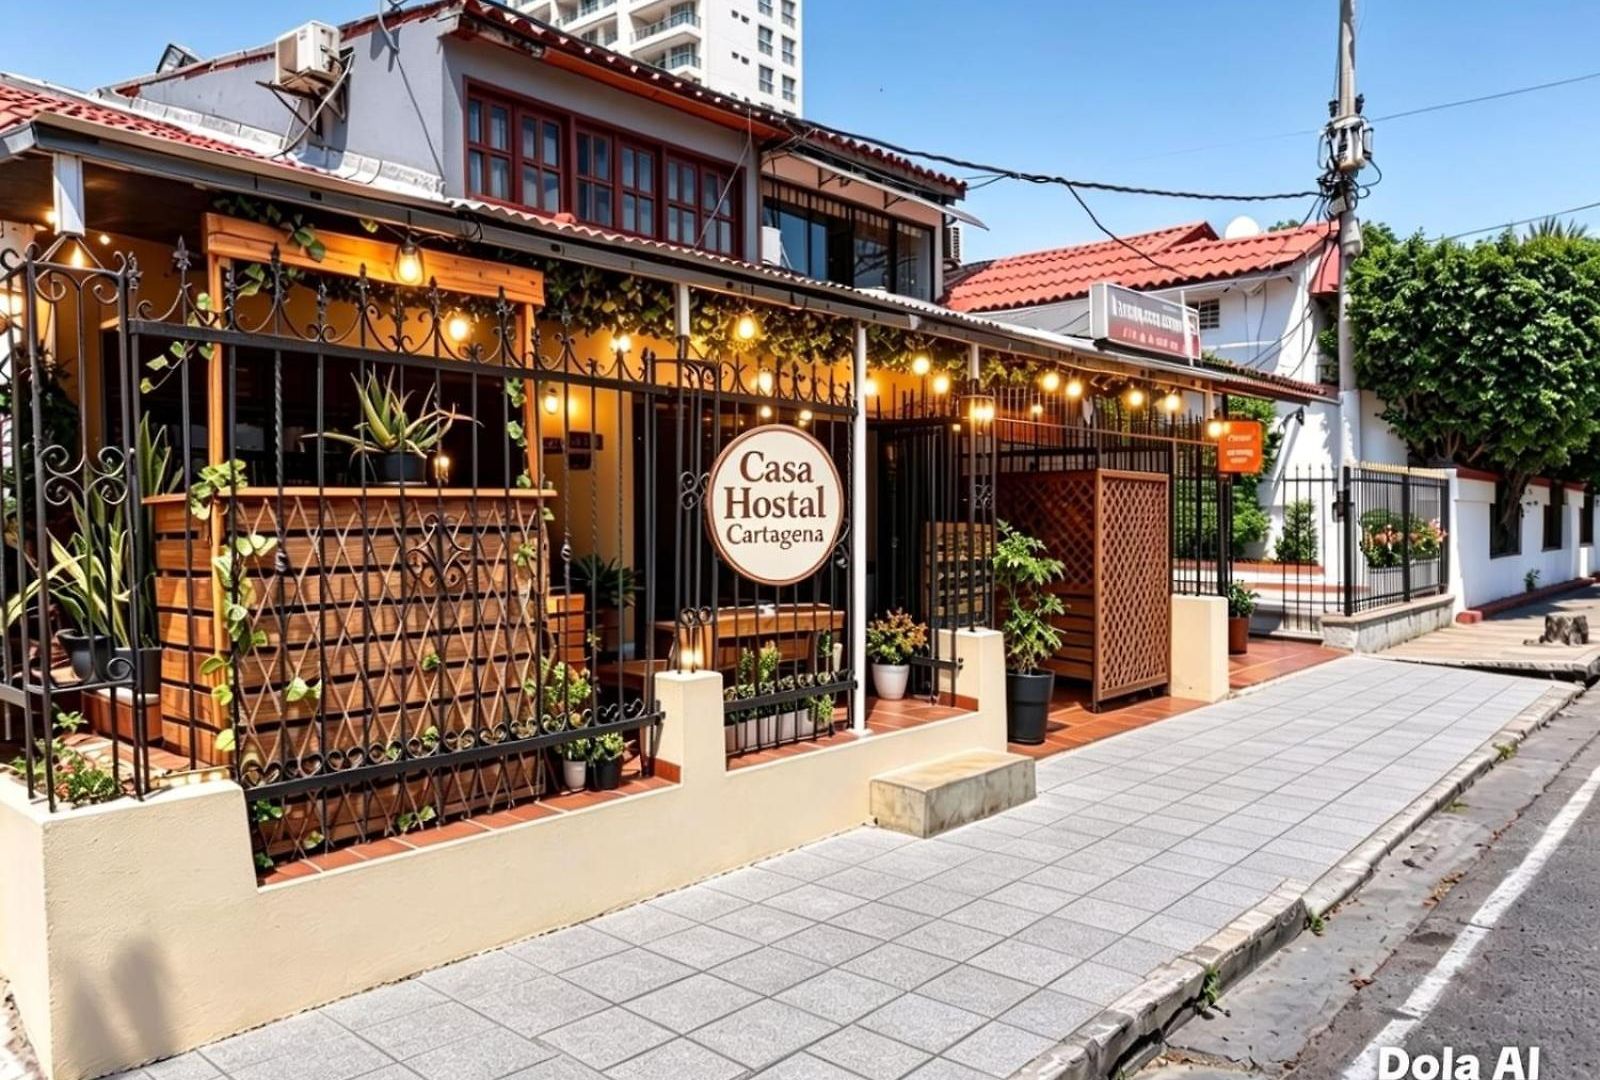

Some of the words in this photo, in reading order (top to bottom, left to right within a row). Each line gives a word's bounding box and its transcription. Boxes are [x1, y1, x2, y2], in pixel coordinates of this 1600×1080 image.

[740, 450, 814, 483] Casa
[723, 485, 826, 520] Hostal
[726, 523, 824, 550] Cartagena
